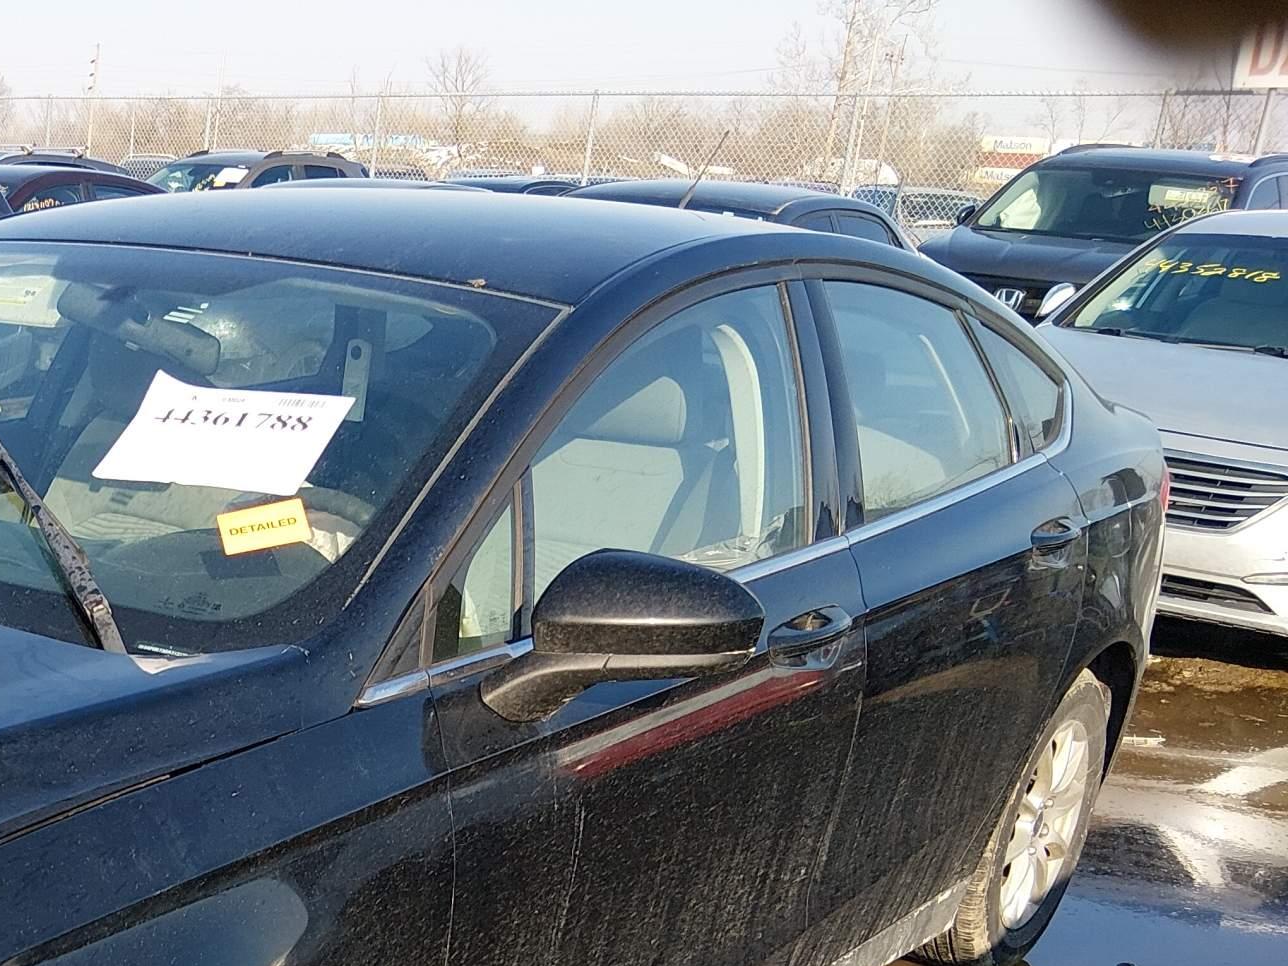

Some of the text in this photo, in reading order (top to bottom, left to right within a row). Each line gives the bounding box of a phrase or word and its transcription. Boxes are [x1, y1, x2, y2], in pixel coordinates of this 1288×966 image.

[992, 139, 1033, 153] Matson
[153, 407, 313, 432] 44361788
[228, 516, 297, 537] DETAILED
